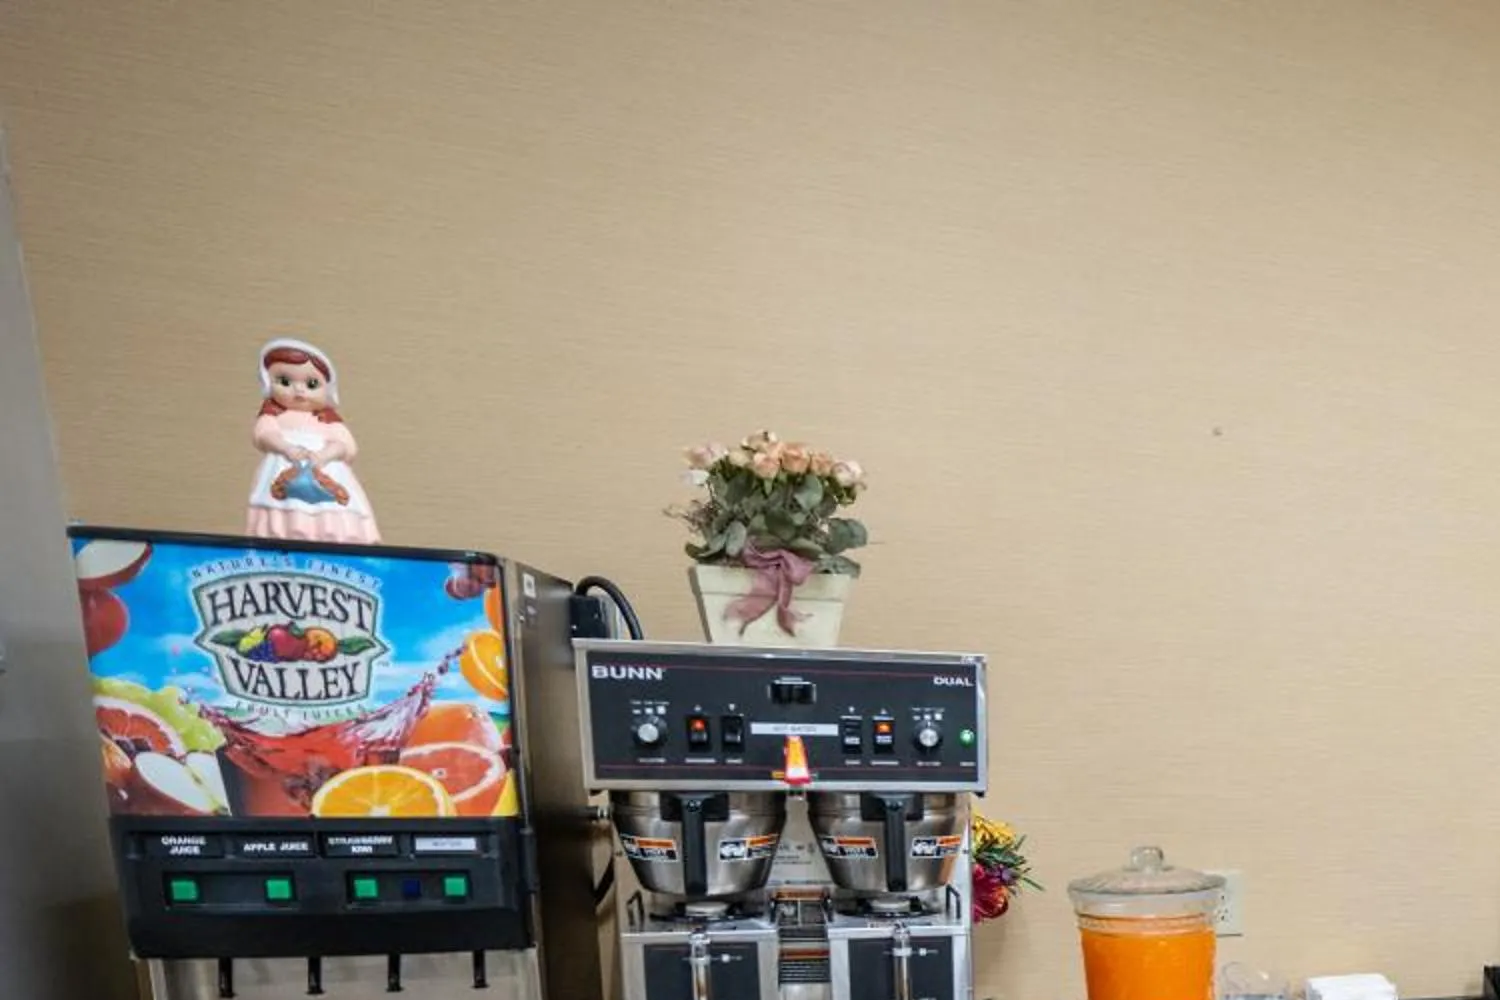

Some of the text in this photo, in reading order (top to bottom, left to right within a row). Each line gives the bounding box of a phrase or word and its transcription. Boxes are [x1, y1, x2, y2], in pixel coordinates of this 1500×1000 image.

[206, 580, 373, 632] HARVEST
[226, 653, 362, 700] VALLEY
[591, 665, 663, 680] BUNN
[933, 676, 974, 687] DUAL
[161, 836, 206, 846] ORANGE
[243, 841, 309, 852] APPLE JUICE
[169, 845, 200, 856] JUICE
